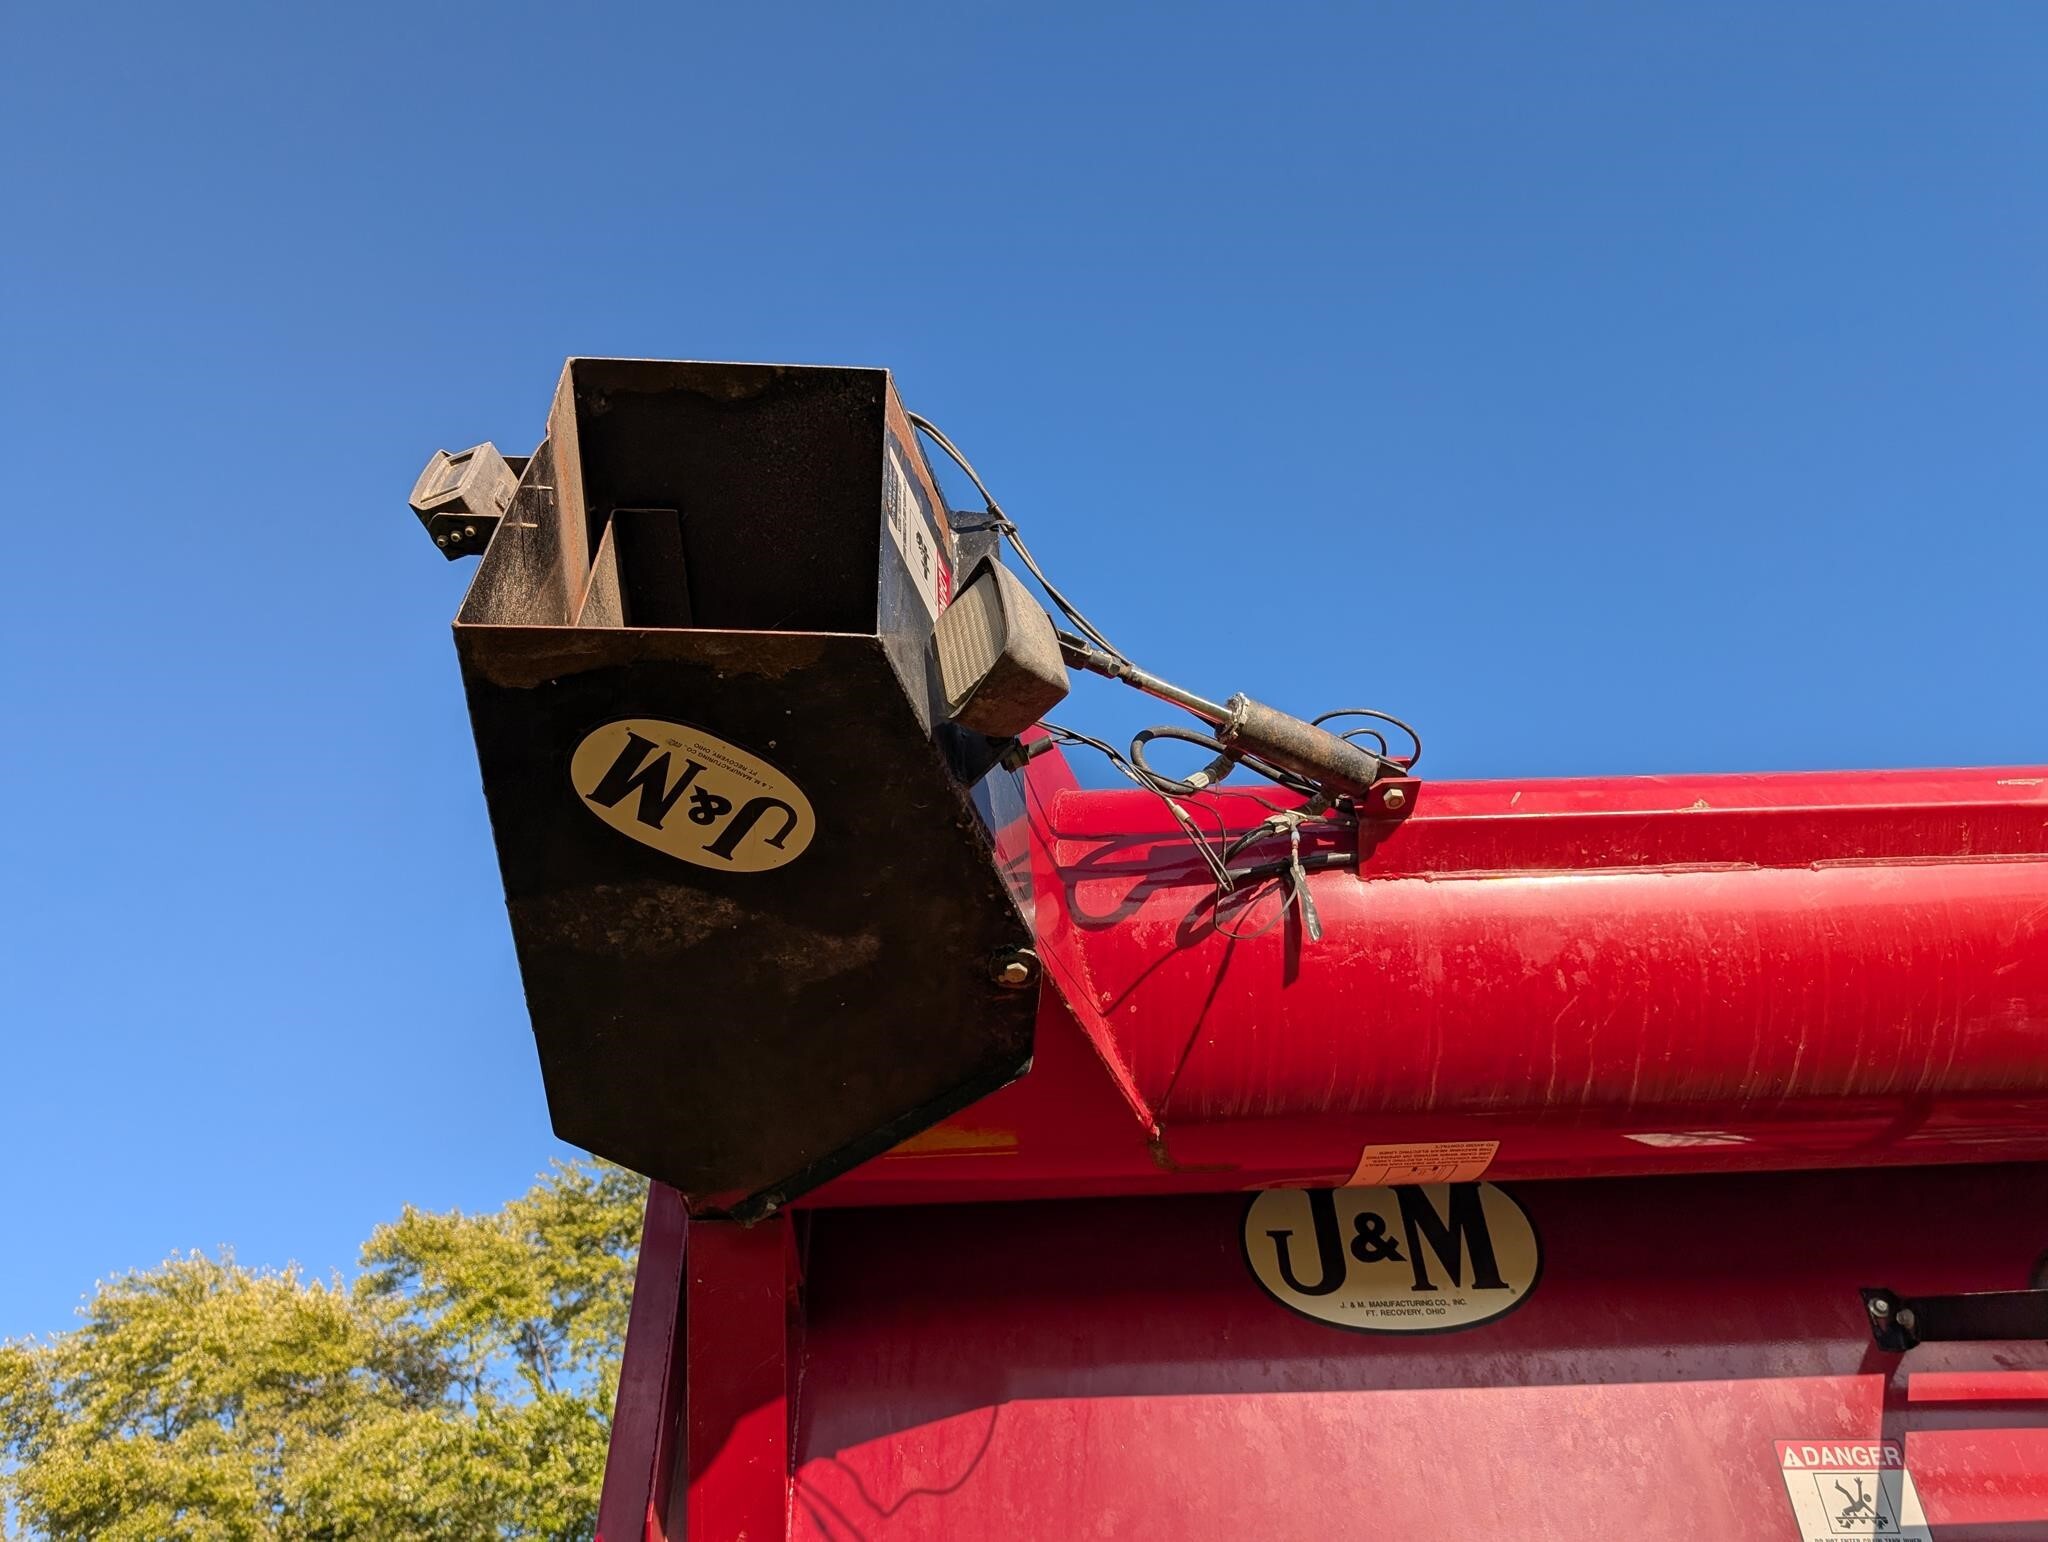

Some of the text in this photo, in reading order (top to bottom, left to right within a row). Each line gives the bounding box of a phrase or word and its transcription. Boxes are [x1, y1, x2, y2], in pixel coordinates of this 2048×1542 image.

[693, 742, 711, 753] OHIO
[697, 752, 753, 781] MANUFACTURING
[585, 731, 798, 861] J&M
[1266, 1181, 1510, 1296] J&M
[1365, 1309, 1378, 1317] FT.
[1368, 1299, 1434, 1308] MANUFACTURING
[1802, 1446, 1903, 1466] DANGER
